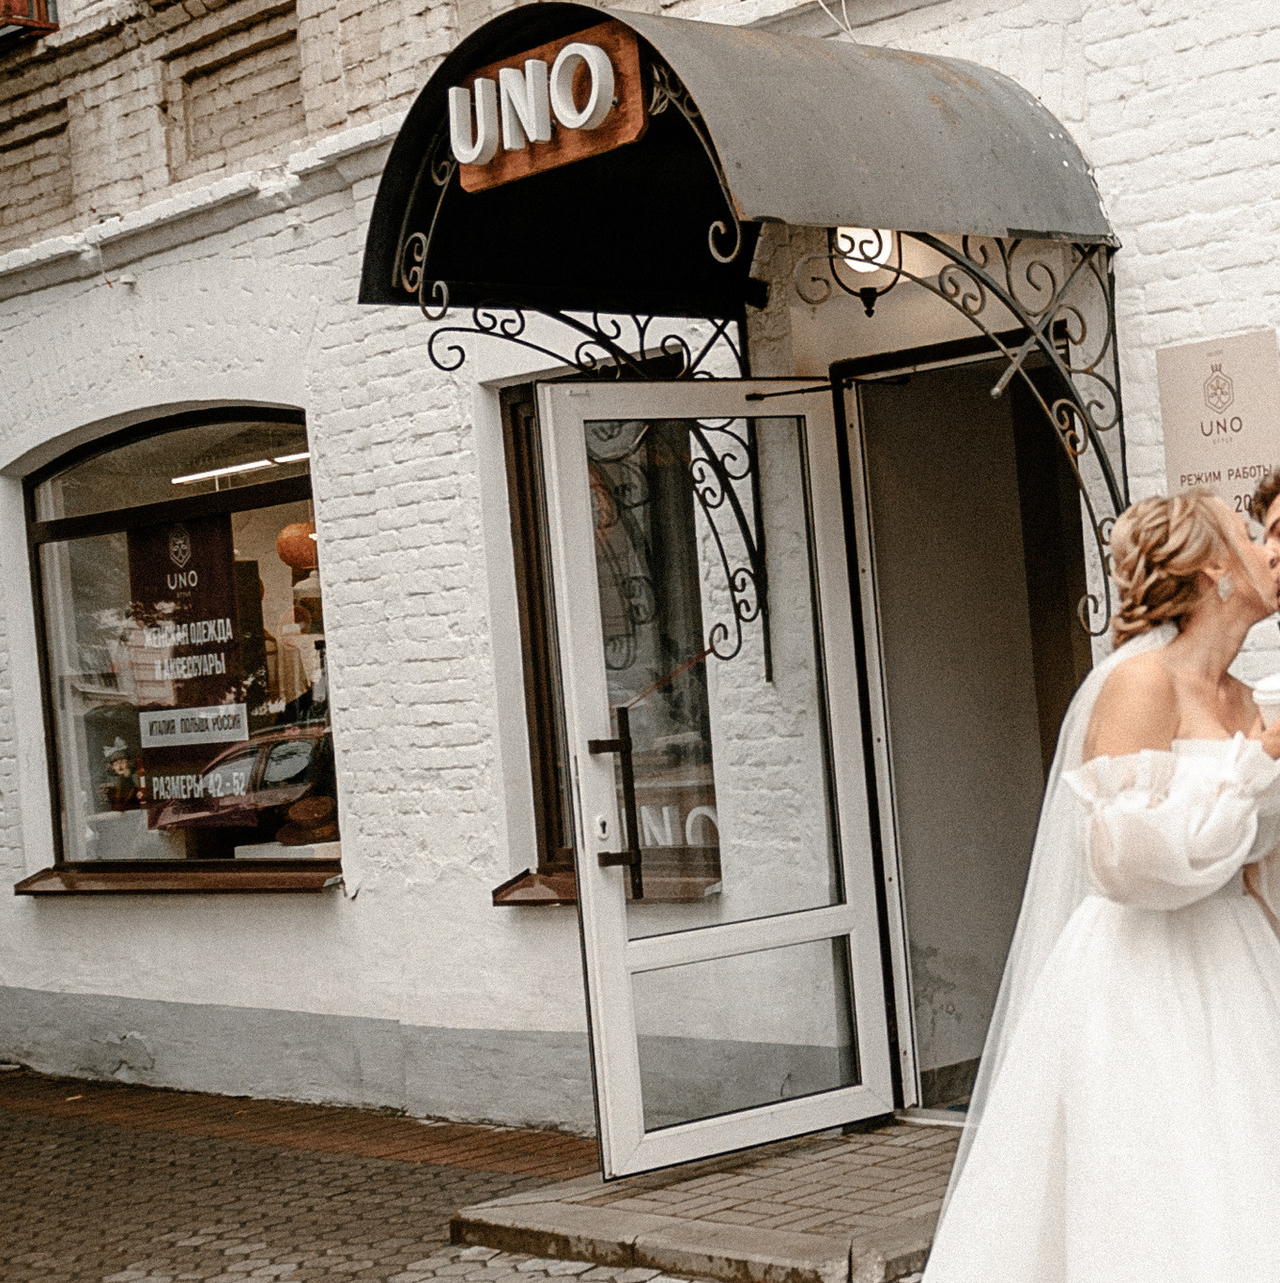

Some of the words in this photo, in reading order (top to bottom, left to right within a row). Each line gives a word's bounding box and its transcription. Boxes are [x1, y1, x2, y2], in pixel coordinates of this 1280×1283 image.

[449, 41, 614, 165] UNO
[1200, 416, 1242, 436] UNO
[1180, 471, 1222, 486] РЕЖИМ
[1227, 464, 1273, 481] РАБОТЫ
[166, 570, 198, 590] UNO
[190, 618, 233, 646] ОДЕЖДА
[152, 774, 204, 800] РАЗМЕРЫ
